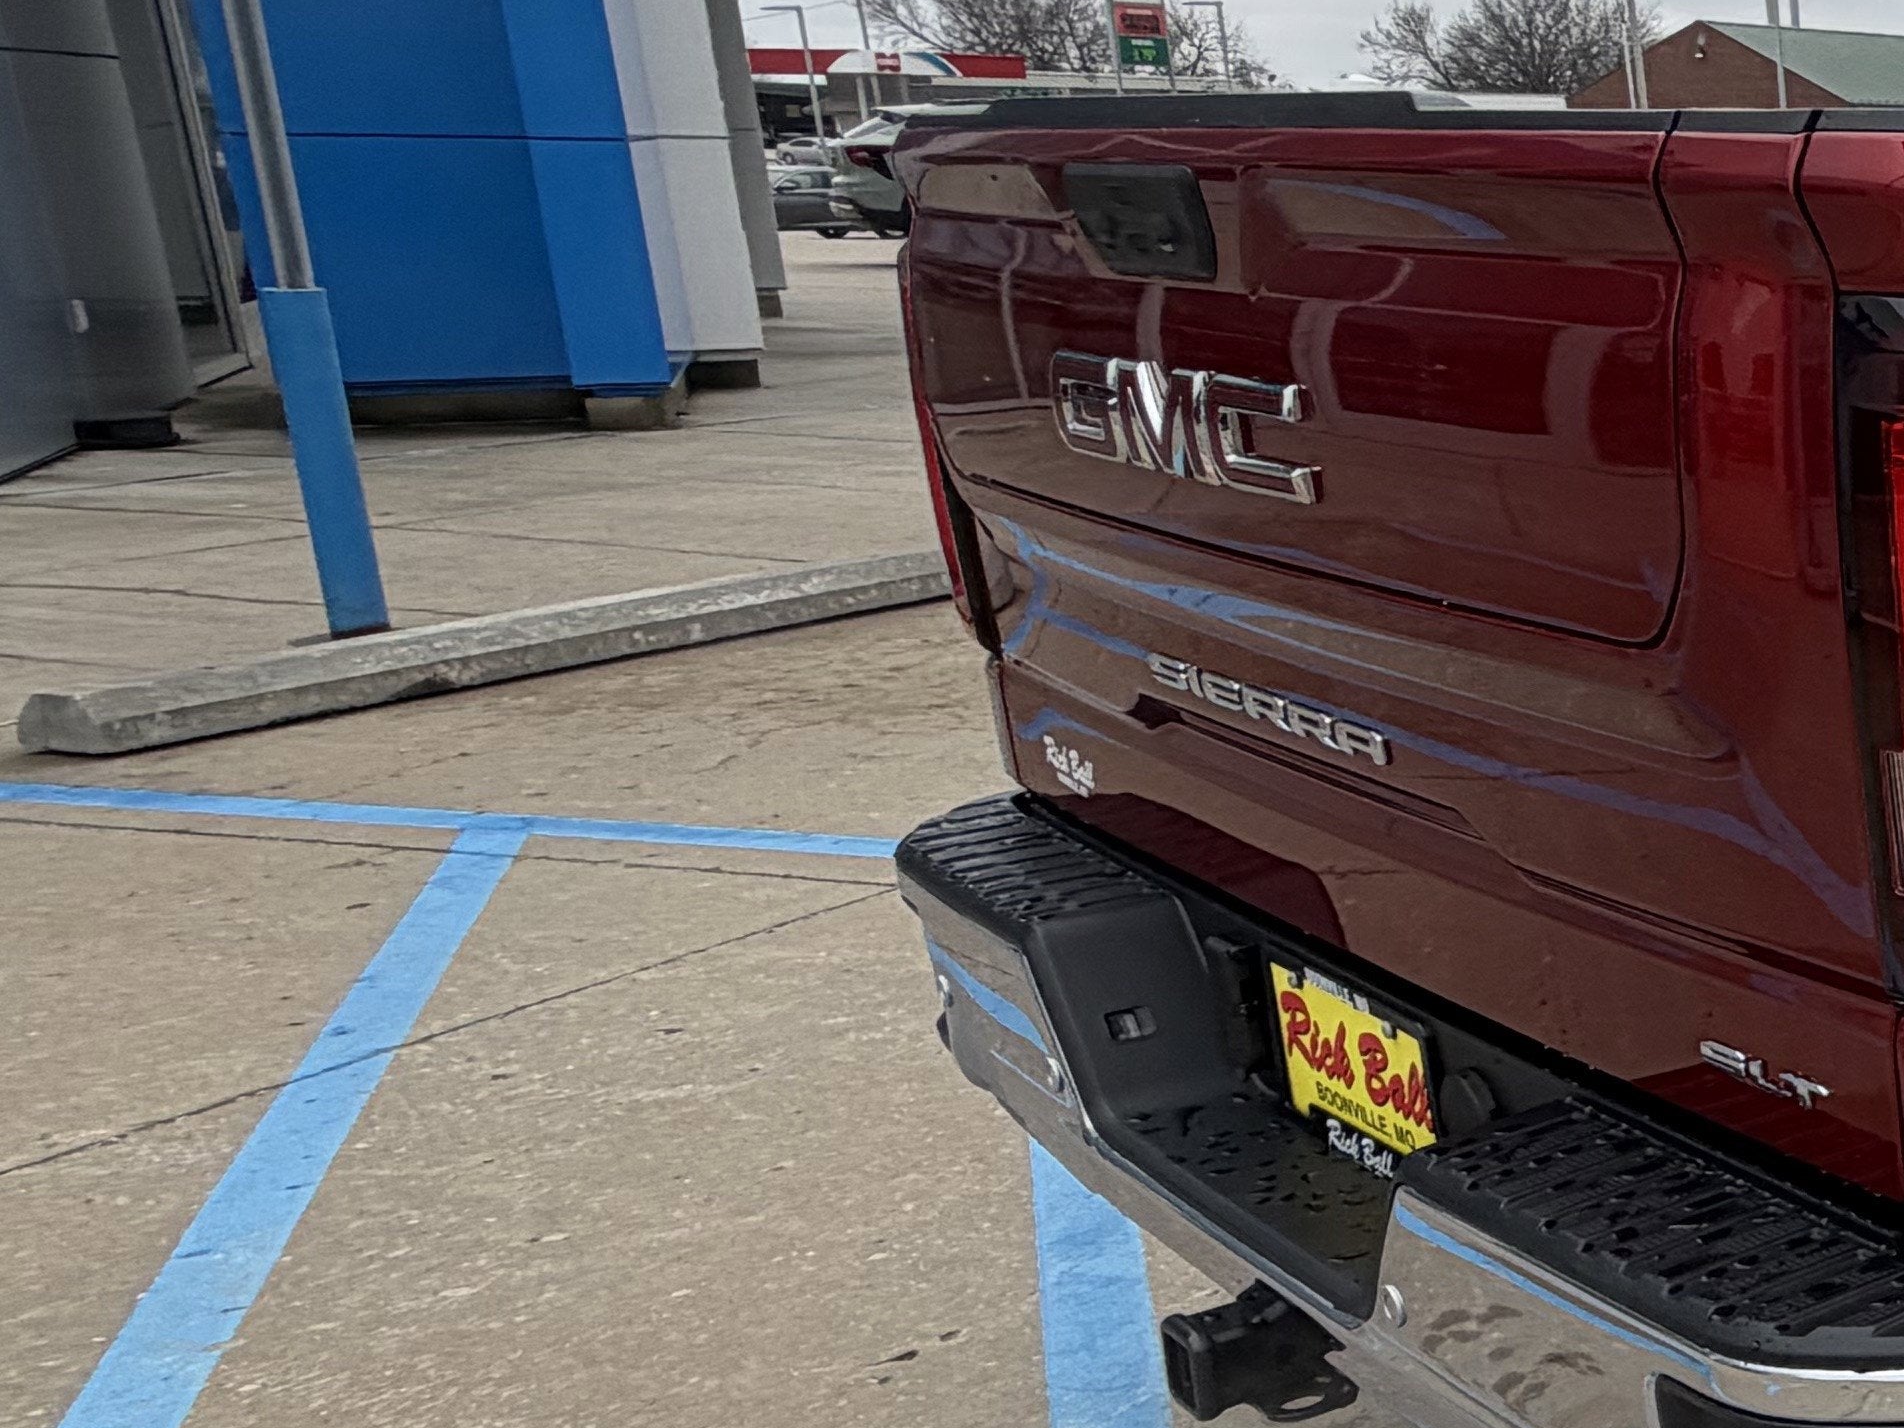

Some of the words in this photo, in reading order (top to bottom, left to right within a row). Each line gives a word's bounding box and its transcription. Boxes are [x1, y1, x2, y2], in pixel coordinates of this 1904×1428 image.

[1051, 350, 1322, 504] GMC
[1149, 652, 1391, 766] SIERRA
[1280, 990, 1355, 1090] Rick
[1358, 1032, 1434, 1133] Ball
[1700, 1040, 1832, 1110] SLT
[1325, 1118, 1359, 1160] Rick
[1361, 1137, 1394, 1179] Ball
[1394, 1124, 1416, 1150] MO
